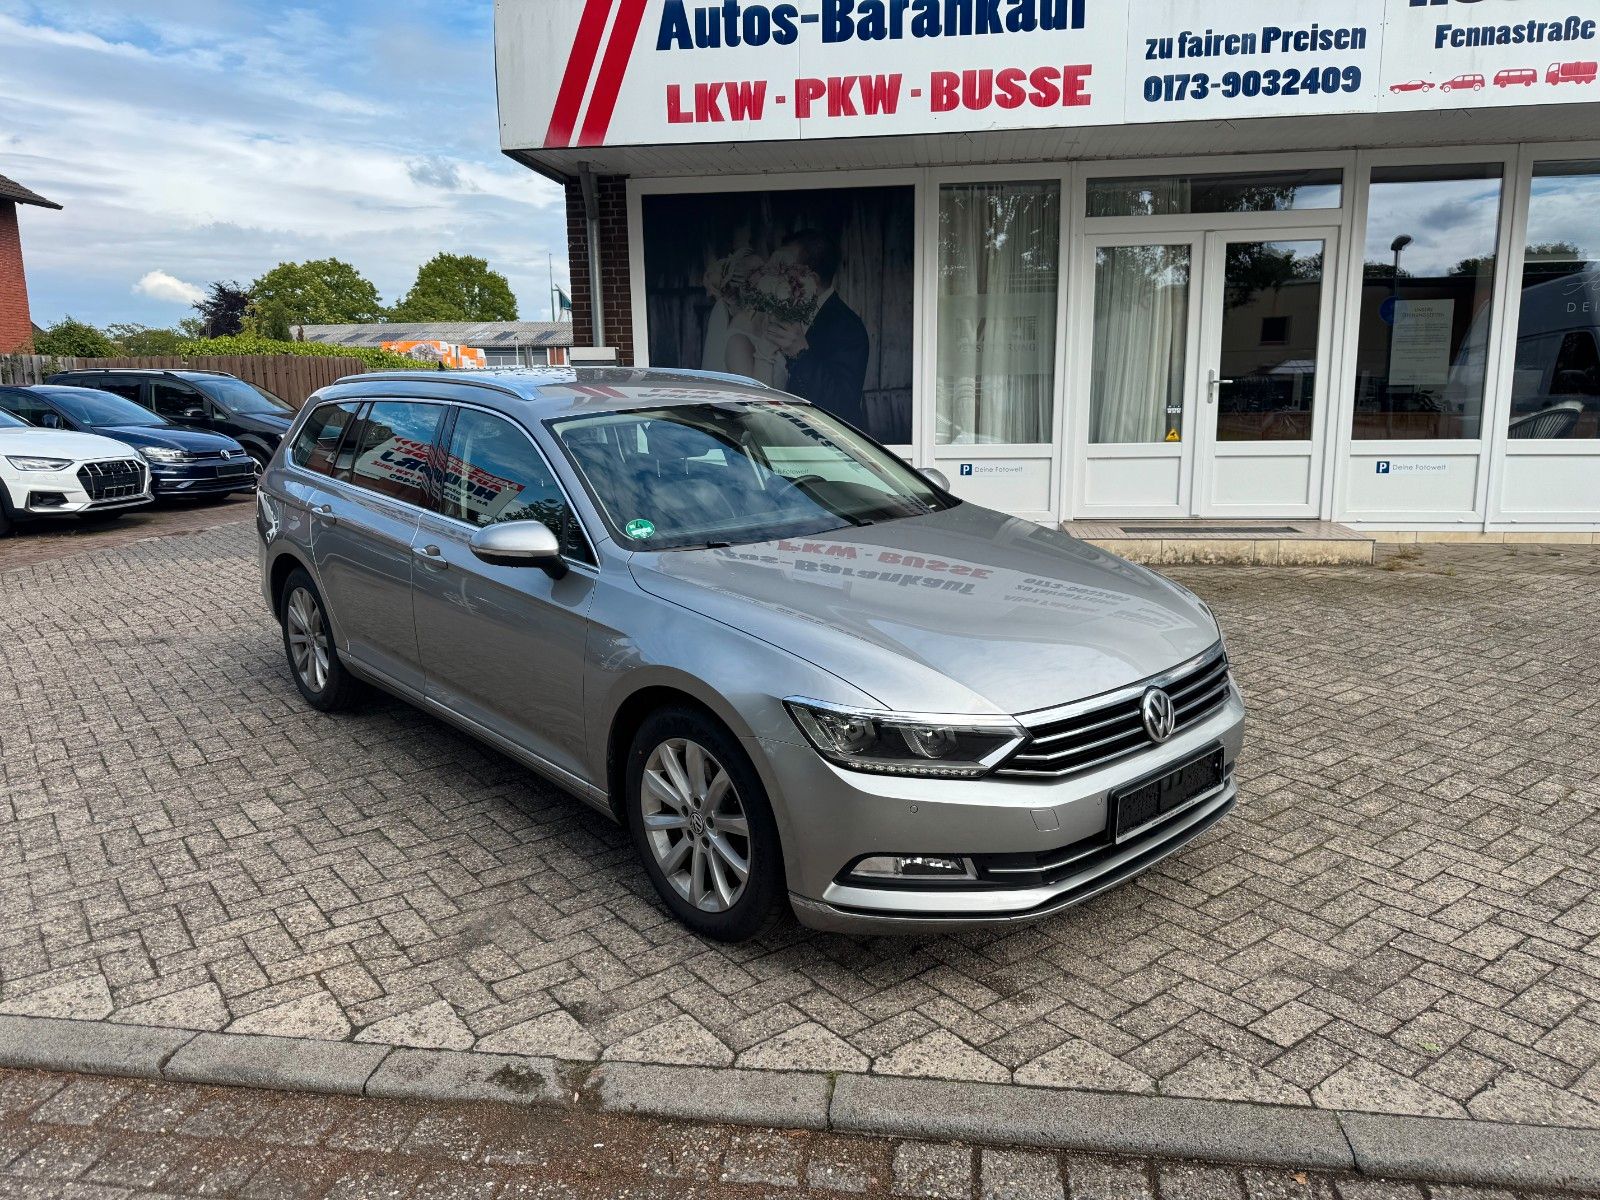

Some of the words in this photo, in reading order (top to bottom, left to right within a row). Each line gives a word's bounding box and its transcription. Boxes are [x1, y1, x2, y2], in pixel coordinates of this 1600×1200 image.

[1145, 37, 1173, 61] zu
[1178, 29, 1255, 58] fairen
[1261, 23, 1367, 54] Preisen
[1435, 15, 1596, 49] Fennastraße
[666, 80, 767, 124] LKW
[795, 73, 902, 119] PKW
[930, 64, 1092, 112] BUSSE
[1143, 65, 1362, 102] 0173-9032409
